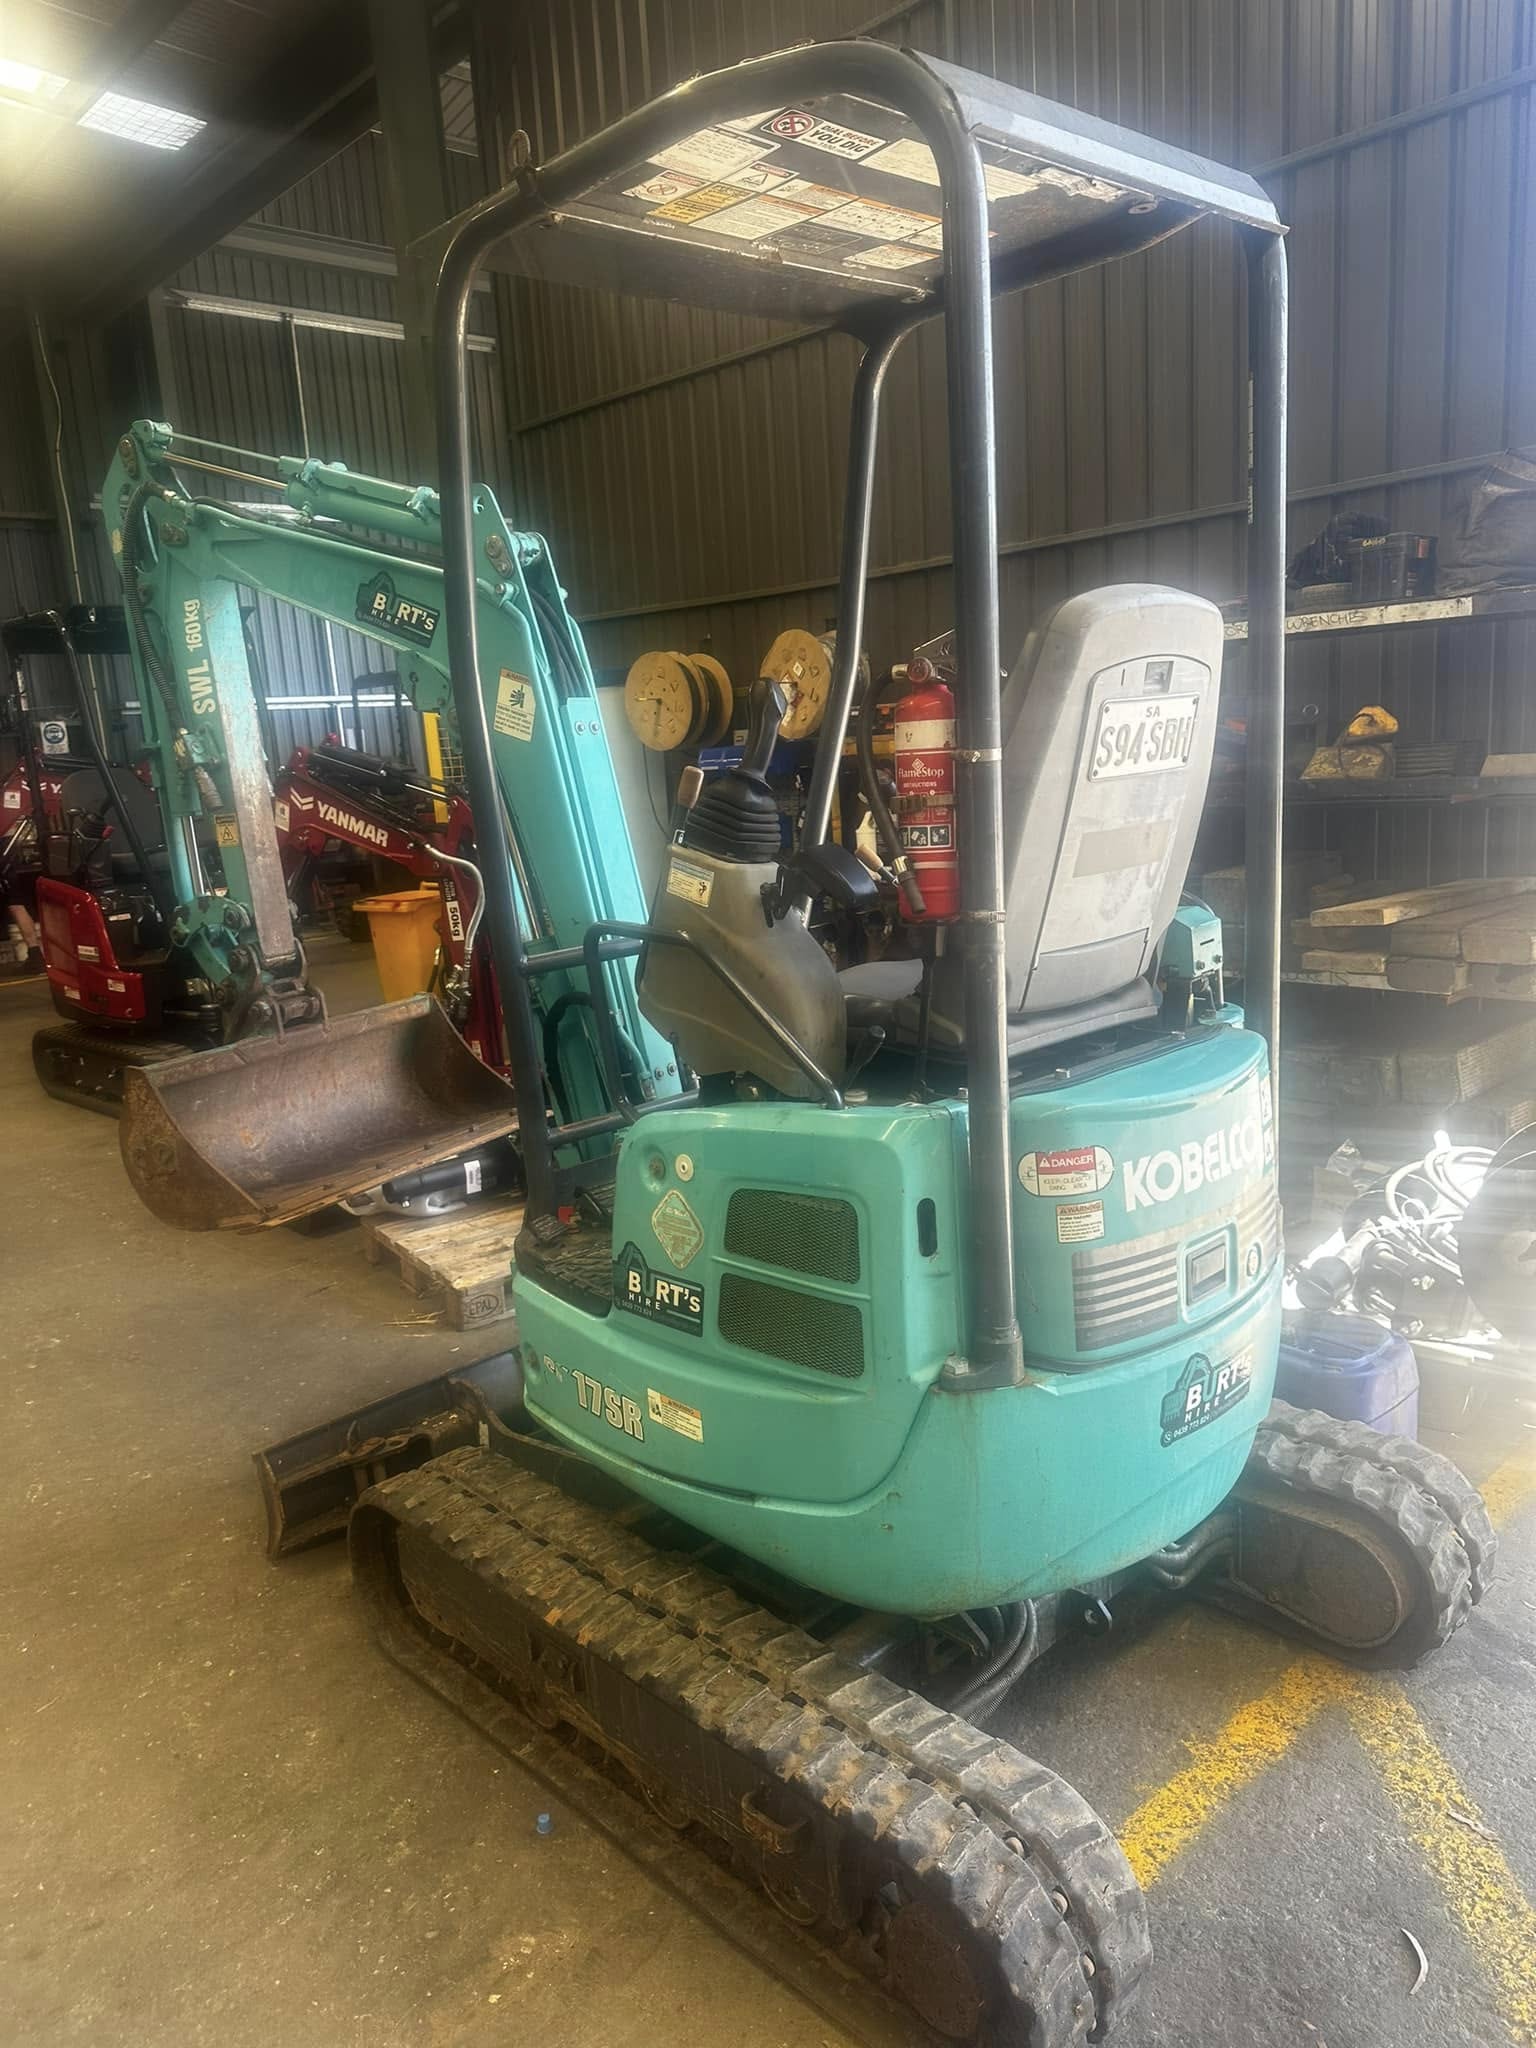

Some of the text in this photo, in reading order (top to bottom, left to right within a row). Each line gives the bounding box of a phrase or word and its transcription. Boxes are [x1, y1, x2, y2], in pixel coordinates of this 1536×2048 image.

[810, 129, 869, 153] YOU DIG
[821, 125, 878, 146] DIAL BEFORE
[371, 609, 400, 625] HIRE
[373, 592, 435, 630] BURT'S
[184, 598, 216, 715] SWL 160kg
[1145, 706, 1161, 718] SA
[317, 800, 389, 847] YANMAR
[449, 906, 460, 937] 50kg
[1051, 1154, 1094, 1168] DANGER
[1123, 1116, 1262, 1212] KOBELCO
[628, 1270, 700, 1313] BURT'S
[629, 1293, 661, 1310] HIRE
[571, 1368, 645, 1443] 17SR
[1185, 1396, 1220, 1423] HIRE
